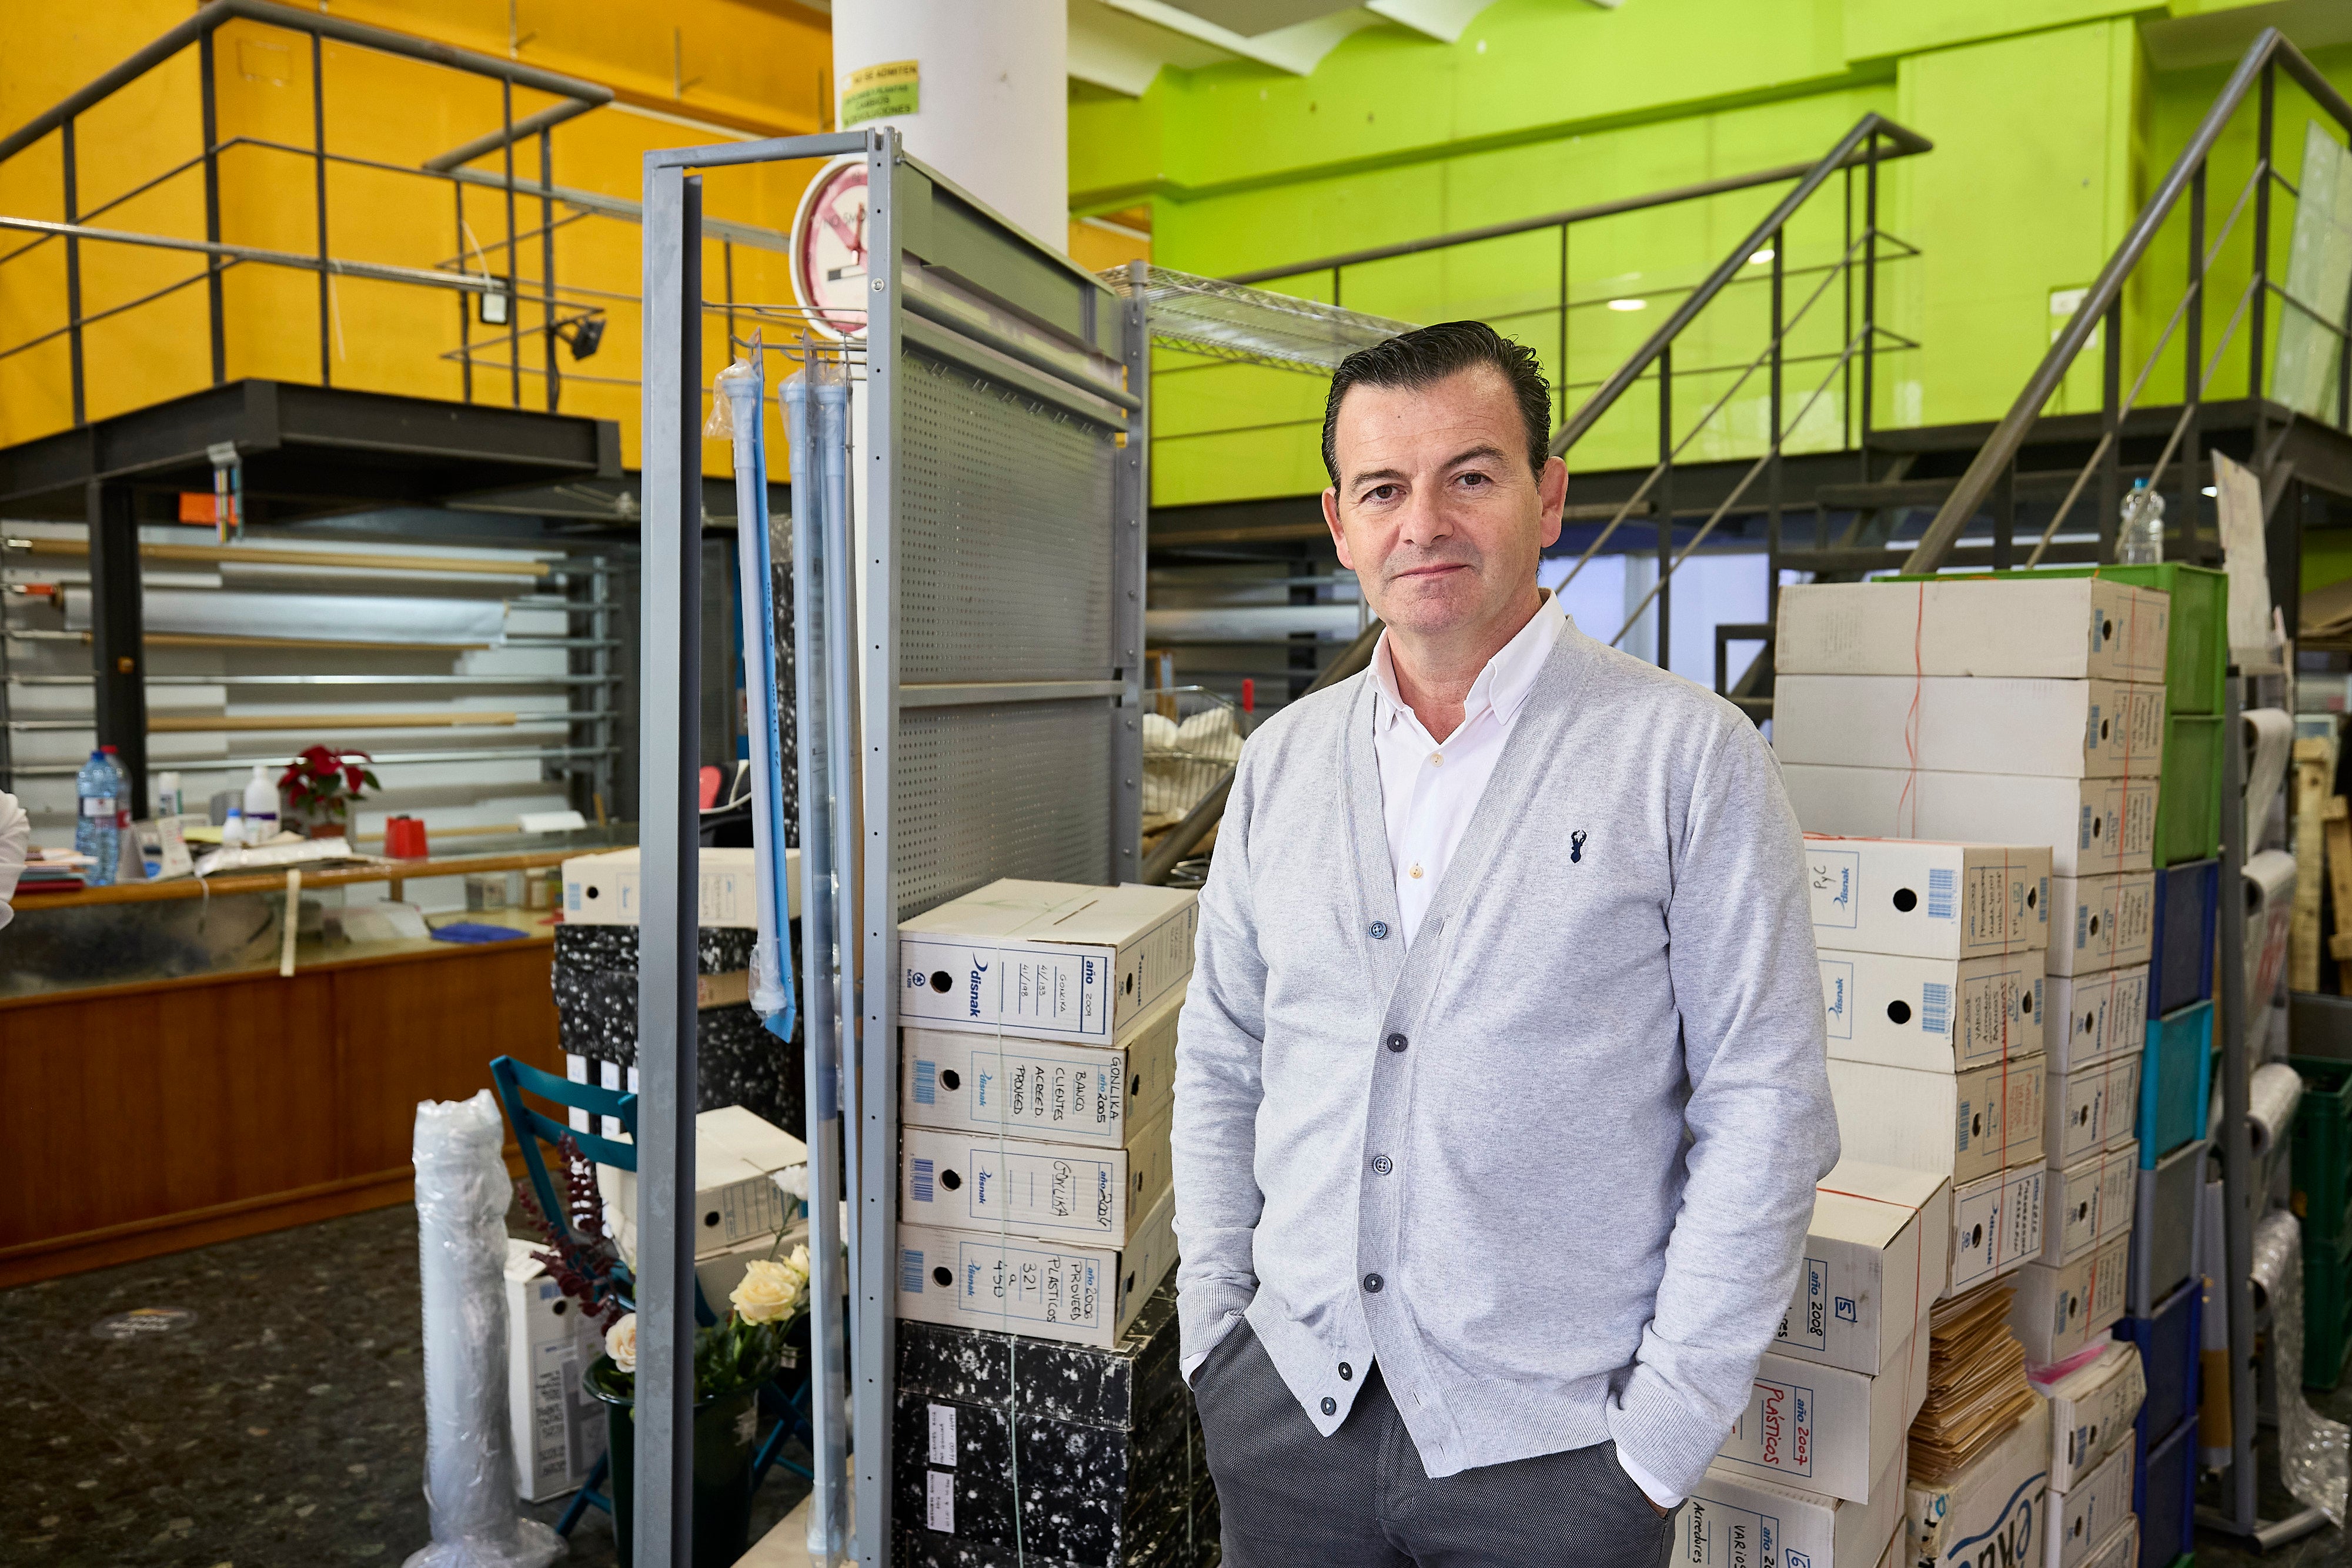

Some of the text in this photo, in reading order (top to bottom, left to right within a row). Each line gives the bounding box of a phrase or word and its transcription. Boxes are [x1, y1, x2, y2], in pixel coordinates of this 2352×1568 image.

[877, 65, 917, 78] ADMITEN
[1840, 867, 1849, 904] disnak
[970, 971, 979, 1017] disnak
[1835, 977, 1844, 1014] disnak
[1054, 1068, 1064, 1121] CLIENTES
[1074, 1071, 1086, 1111] BANCO
[1097, 1092, 1106, 1122] 2005
[1110, 1057, 1121, 1121] GONLIKA
[978, 1173, 987, 1204] disnak
[968, 1265, 976, 1297] disnak
[1023, 1263, 1037, 1290] 321
[1047, 1256, 1060, 1323] PLASTICOS
[1084, 1288, 1093, 1320] 2006
[1809, 1271, 1823, 1337] año 2008
[1838, 1302, 1852, 1317] 5
[1795, 1424, 1808, 1465] 2007
[1692, 1502, 1704, 1563] Acreedores
[1763, 1526, 1772, 1552] año
